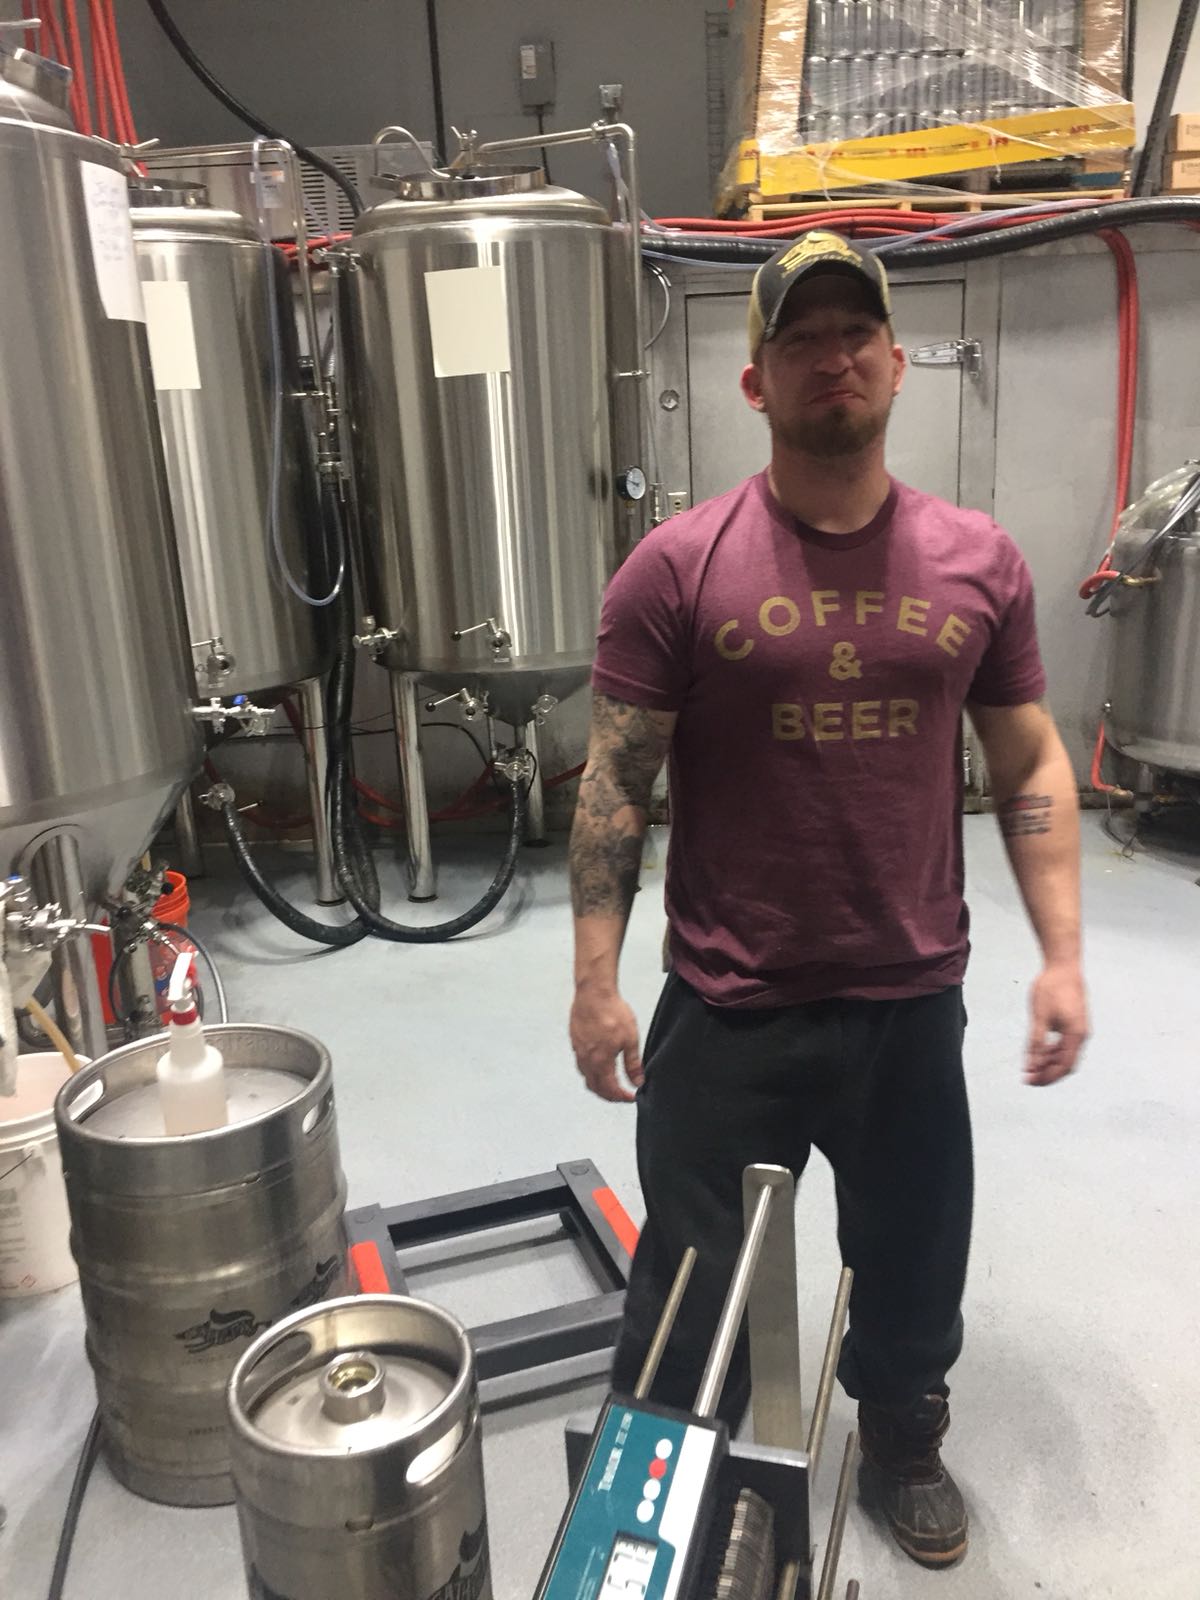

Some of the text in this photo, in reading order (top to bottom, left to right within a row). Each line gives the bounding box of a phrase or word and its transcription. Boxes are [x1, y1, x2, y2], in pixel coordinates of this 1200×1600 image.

[714, 589, 972, 660] COFFEE
[829, 641, 862, 680] &
[772, 699, 920, 740] BEER
